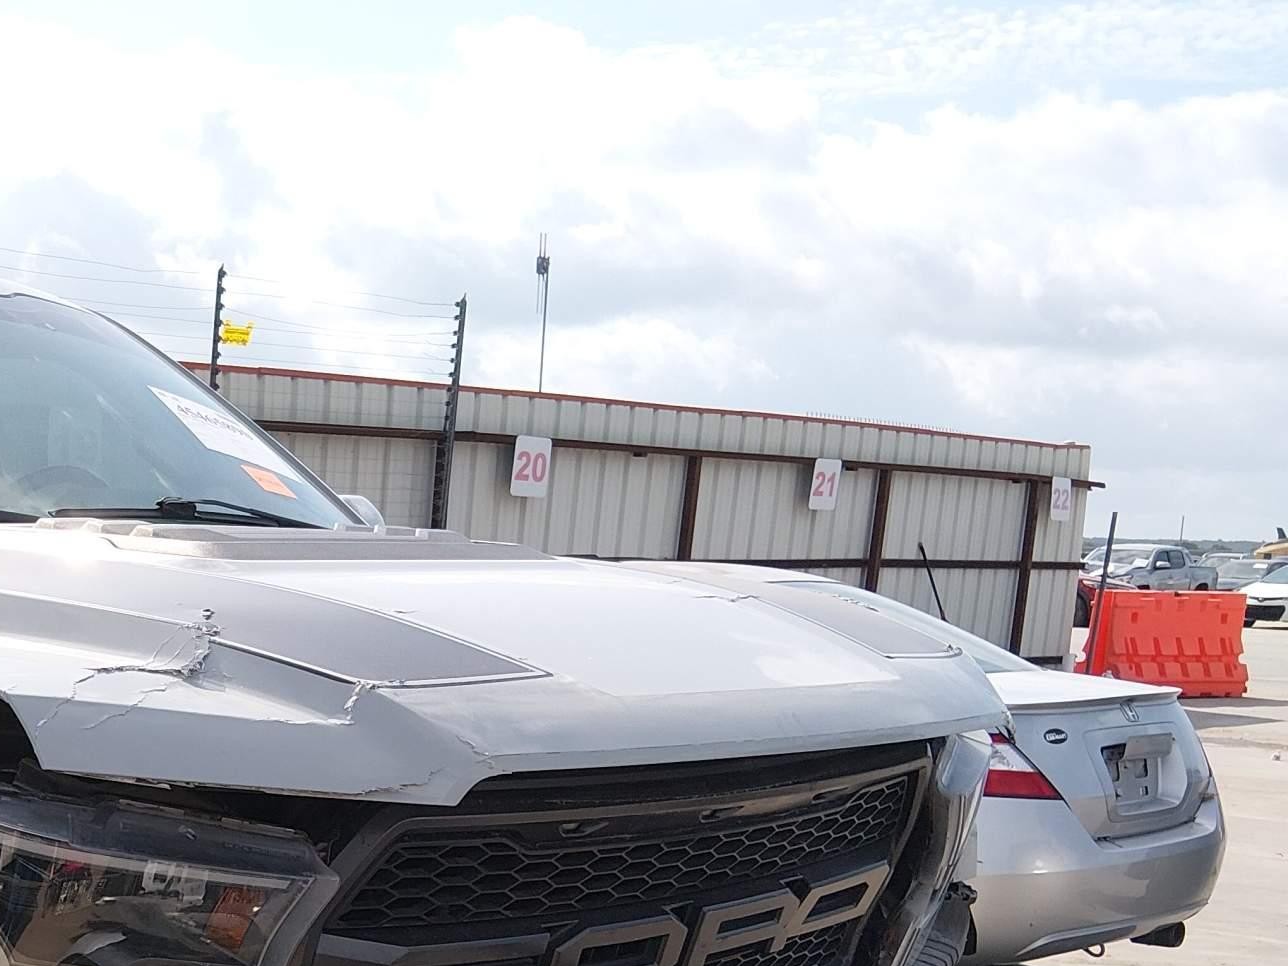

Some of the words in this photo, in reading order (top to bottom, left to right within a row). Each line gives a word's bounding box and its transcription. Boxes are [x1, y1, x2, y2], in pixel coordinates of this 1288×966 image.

[514, 450, 547, 482] 20
[812, 471, 836, 497] 21
[1053, 487, 1069, 511] 22
